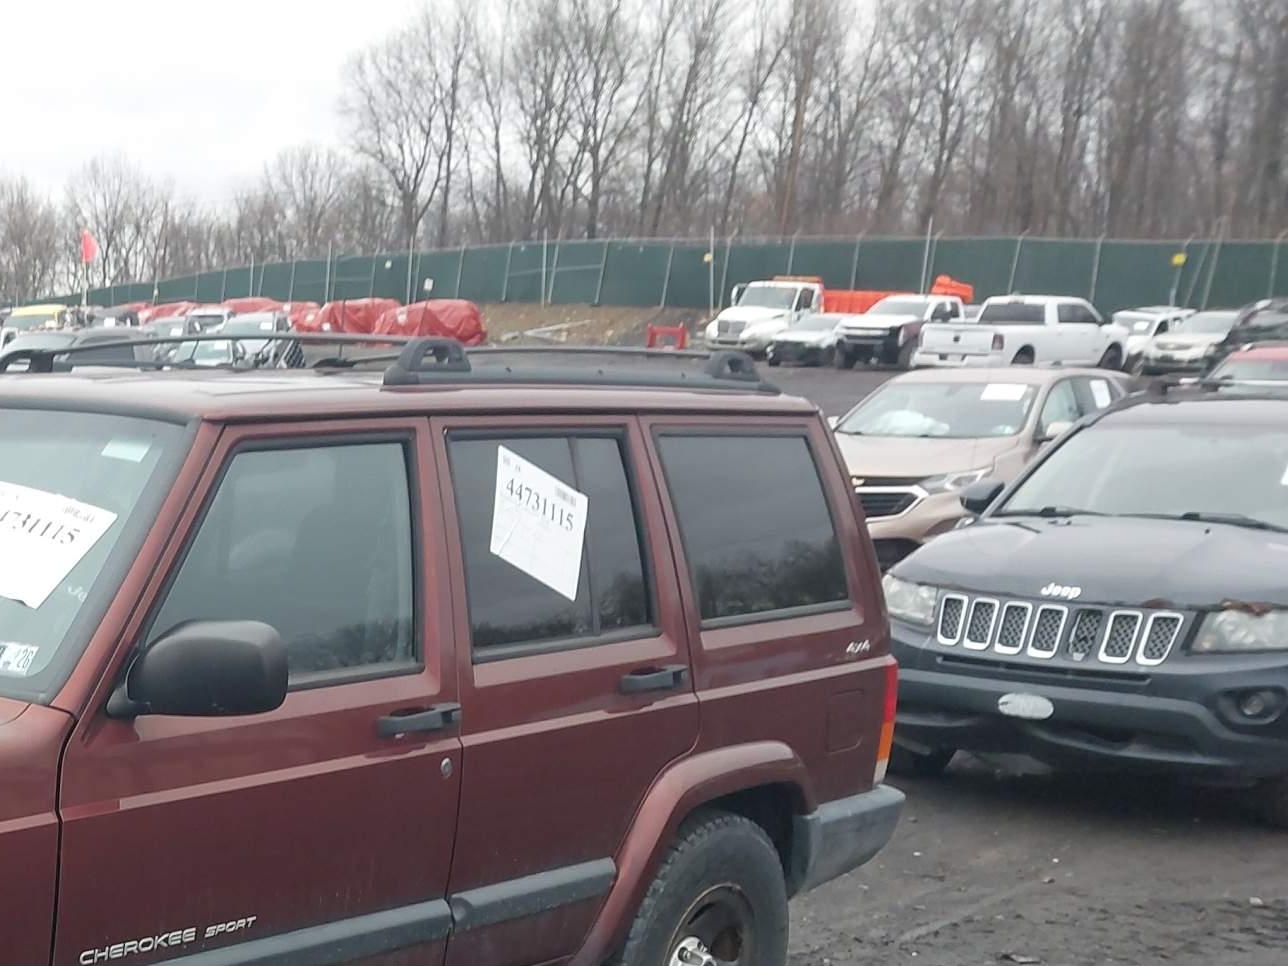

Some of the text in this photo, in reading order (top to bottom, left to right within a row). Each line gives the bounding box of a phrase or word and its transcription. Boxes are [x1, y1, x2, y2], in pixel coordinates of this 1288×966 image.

[506, 478, 574, 532] 44731115
[1040, 582, 1081, 600] Jeep
[79, 916, 257, 966] CHEROKEE SPORT
